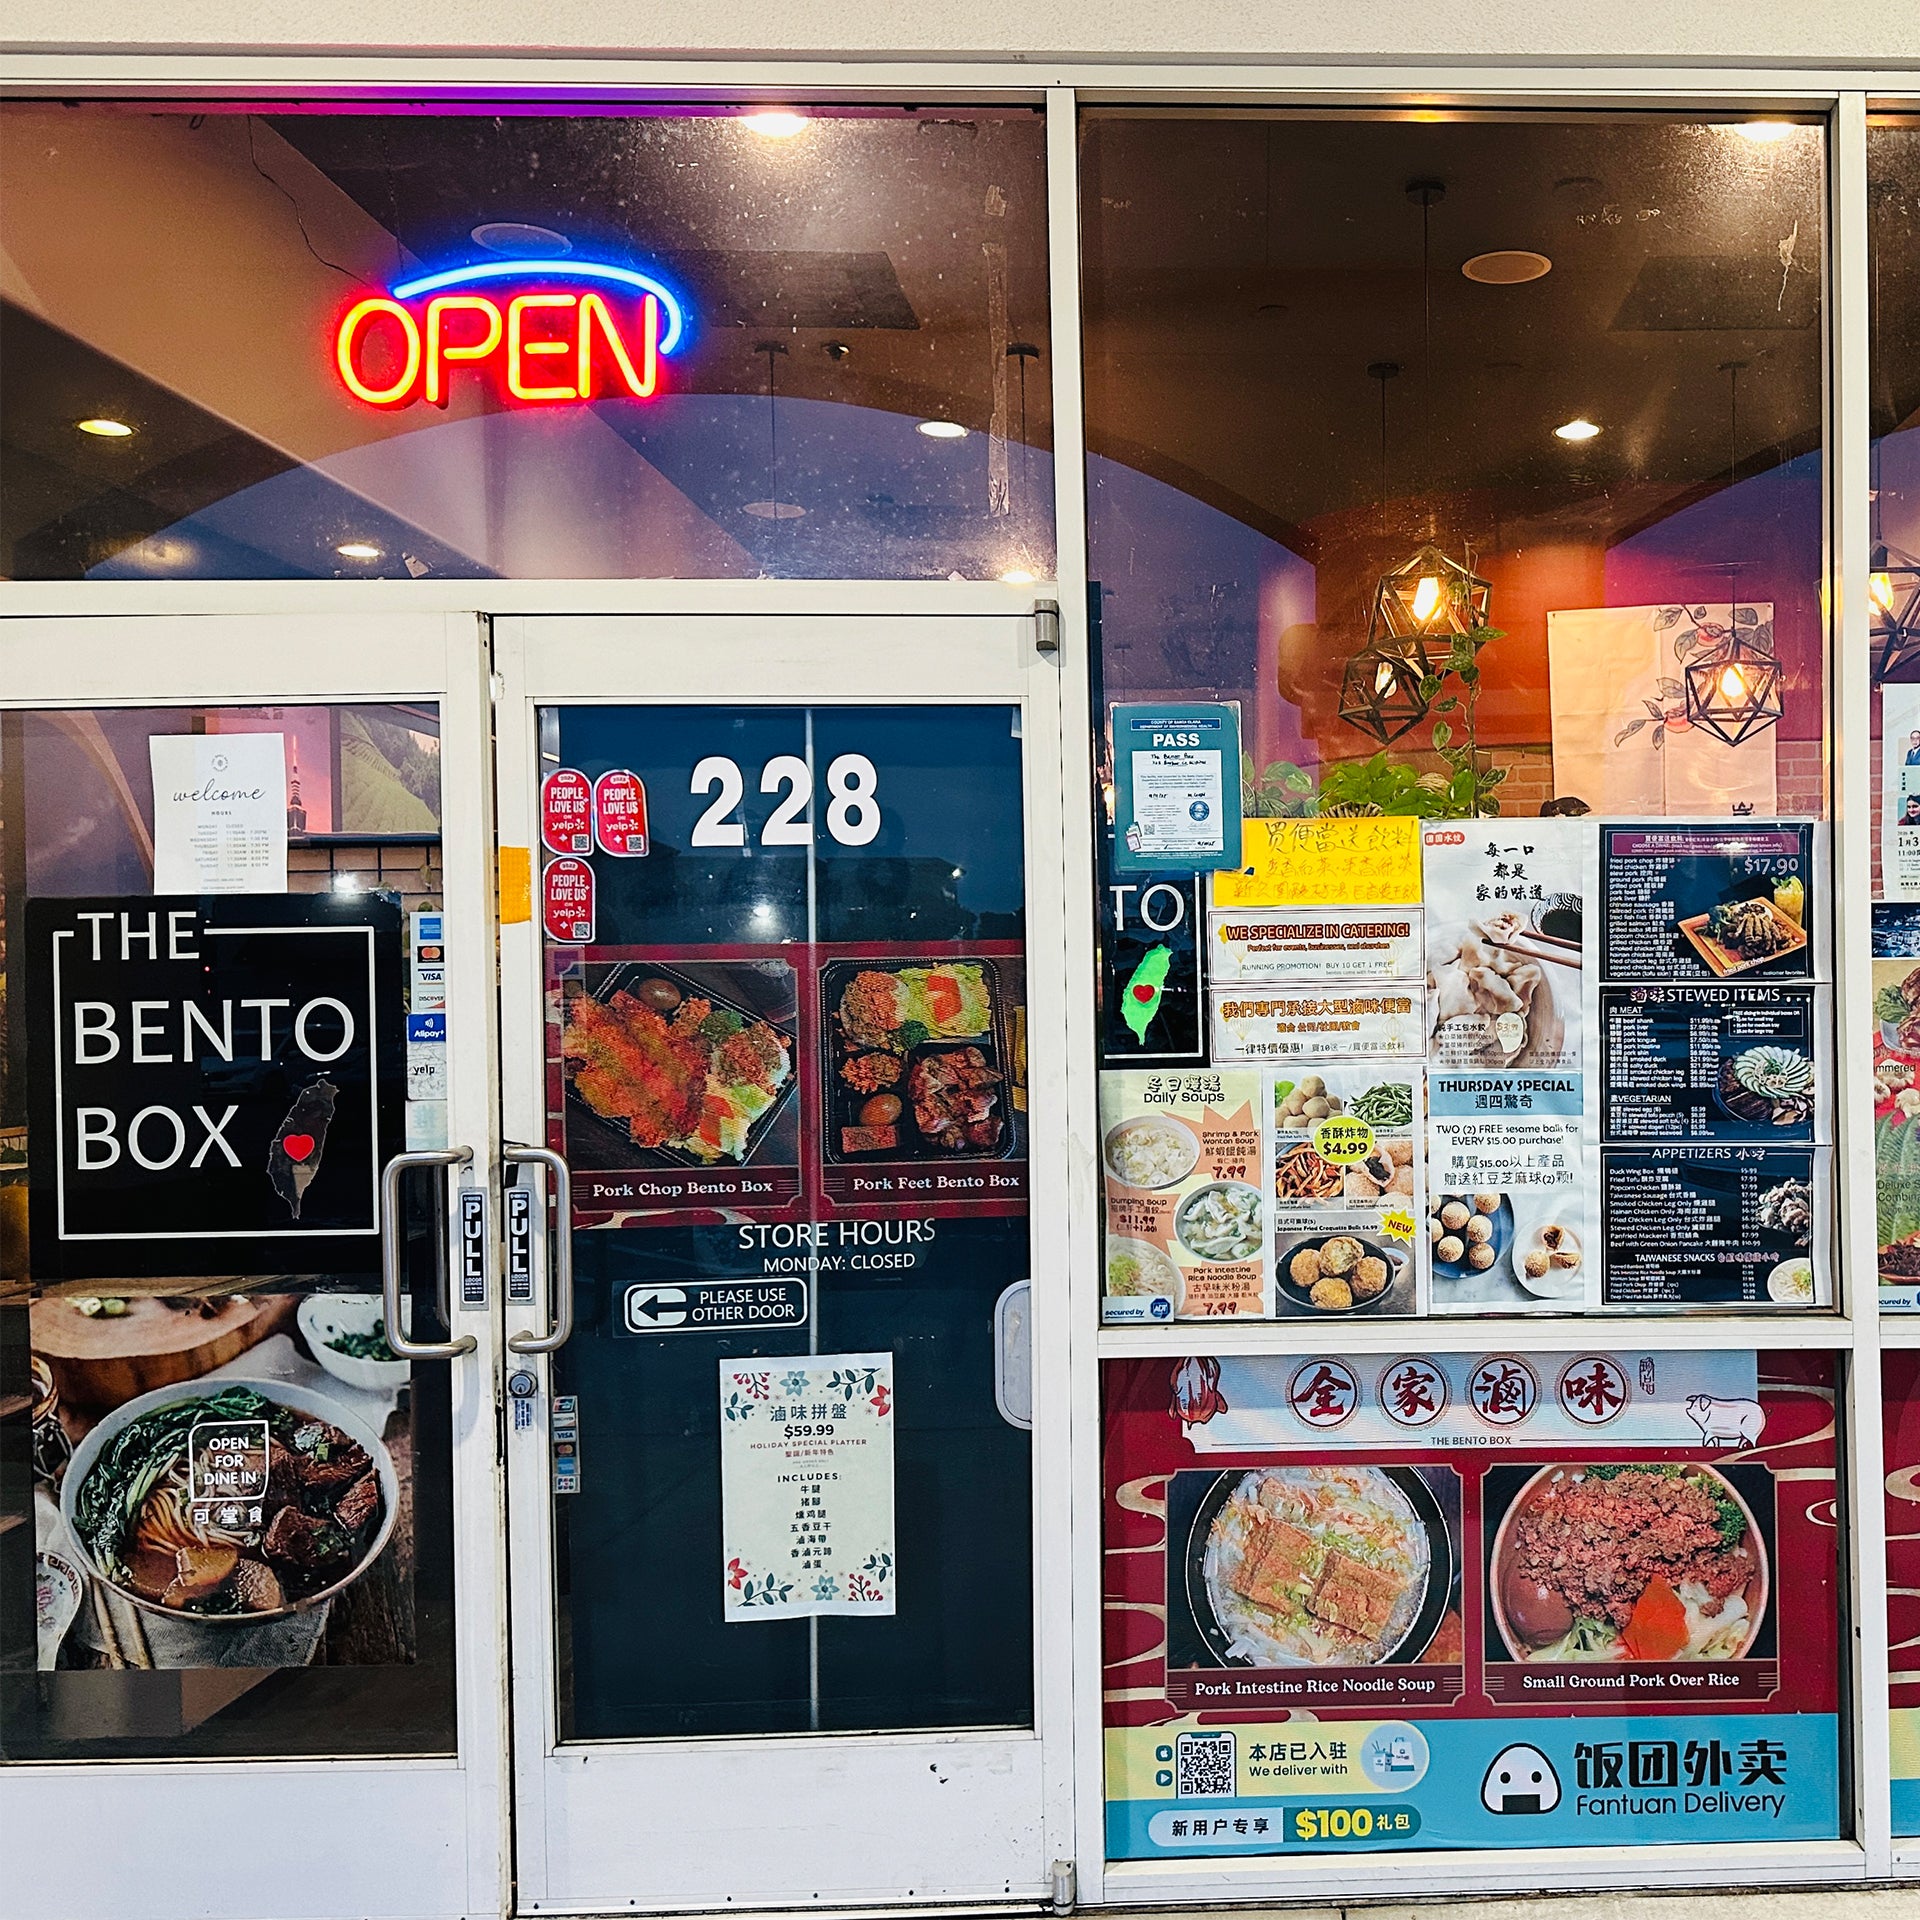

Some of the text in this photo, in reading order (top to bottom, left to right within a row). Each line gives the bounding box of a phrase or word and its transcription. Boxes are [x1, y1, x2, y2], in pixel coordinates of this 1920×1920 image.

[338, 294, 656, 403] OPEN
[1153, 733, 1200, 747] PASS
[173, 778, 265, 801] welcome
[551, 787, 583, 799] PEOPLE
[604, 788, 636, 800] PEOPLE
[550, 801, 585, 813] LOVE US
[690, 754, 880, 846] 228
[603, 802, 638, 814] LOVE US
[552, 822, 574, 831] yelp
[606, 822, 629, 832] yelp
[1484, 842, 1535, 857] 每一口
[1493, 862, 1528, 880] 都是
[1745, 858, 1798, 875] $17.90
[553, 875, 585, 887] PEOPLE
[551, 888, 586, 900] LOVE US
[1476, 884, 1544, 901] 家的味道
[553, 909, 575, 918] yelp
[1109, 884, 1184, 931] TO
[77, 912, 199, 960] THE
[1226, 923, 1410, 940] WE SPECIALIZE IN CATERING!
[422, 973, 442, 981] VISA
[1667, 988, 1780, 1001] STEWED ITEMS
[1223, 997, 1411, 1017] 我們專門承接大型滷味便當
[74, 998, 354, 1064] BENTO
[413, 1065, 435, 1075] yelp
[1439, 1080, 1574, 1093] THURSDAY SPECIAL
[1144, 1091, 1225, 1105] Daily Soups
[1320, 1127, 1369, 1139] 香酥炸物
[1436, 1124, 1578, 1135] TWO (2) FREE sesame balls for
[76, 1106, 242, 1170] BOX
[1451, 1135, 1564, 1146] EVERY $15.00 purchase!
[1323, 1142, 1368, 1155] $4.99
[1652, 1148, 1765, 1160] APPETIZERS 小吃
[1213, 1165, 1246, 1179] 7.99
[593, 1180, 773, 1198] Pork Chop Bento Box
[854, 1174, 1020, 1191] Pork Feet Bento Box
[1878, 1180, 1911, 1189] Deluxe
[1111, 1198, 1144, 1206] Dumpling
[1120, 1215, 1155, 1224] $11.99
[1388, 1220, 1412, 1233] NEW
[465, 1202, 481, 1276] PULL
[511, 1200, 527, 1272] PULL
[739, 1218, 936, 1249] STORE HOURS
[764, 1253, 915, 1273] MONDAY: CLOSED
[1635, 1254, 1682, 1262] TAIWANESE
[700, 1288, 787, 1304] PLEASE USE
[692, 1303, 795, 1322] OTHER DOOR
[1135, 1308, 1144, 1317] by
[1153, 1304, 1167, 1314] ADT
[1203, 1302, 1237, 1315] 7.99
[1289, 1364, 1623, 1419] 全家滷味
[770, 1404, 847, 1422] 滷味拼盤
[784, 1425, 834, 1439] $59.99
[209, 1437, 249, 1450] OPEN
[1431, 1436, 1511, 1445] THE BENTO BOX
[215, 1454, 243, 1467] FOR
[204, 1471, 256, 1485] DINE IN
[194, 1506, 262, 1524] 可堂食
[791, 1522, 831, 1532] 五香豆干
[1195, 1678, 1435, 1696] Pork Intestine Rice Noodle Soup
[1523, 1673, 1740, 1689] Small Ground Pork Over Rice
[1249, 1741, 1347, 1761] 本店已入驻
[1250, 1764, 1348, 1776] We deliver with
[1574, 1740, 1787, 1788] 饭团外卖
[1577, 1792, 1786, 1818] Fantuan Delivery
[1172, 1817, 1269, 1837] 新用户专享
[1296, 1808, 1410, 1840] $100 礼包
